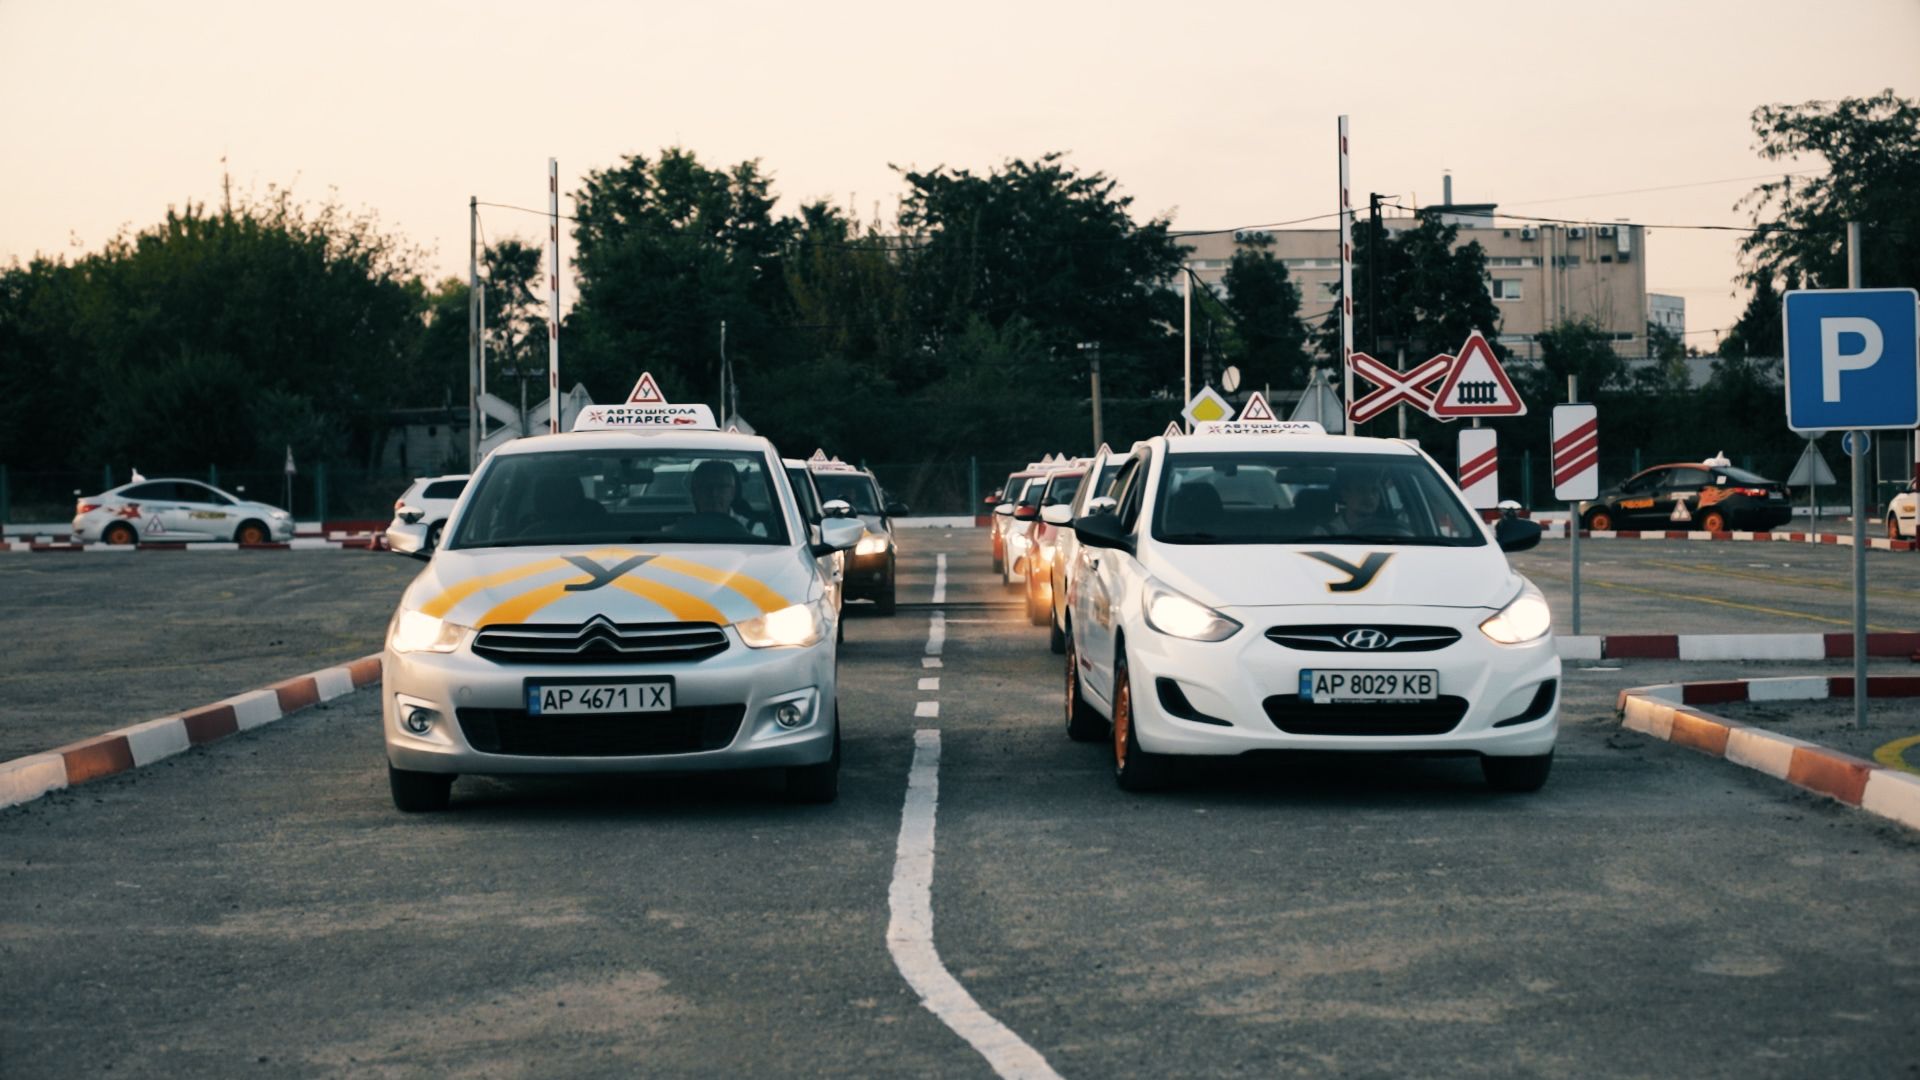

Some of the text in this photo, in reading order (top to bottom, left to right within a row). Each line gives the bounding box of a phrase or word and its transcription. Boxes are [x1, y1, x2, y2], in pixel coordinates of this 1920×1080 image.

[1820, 316, 1884, 403] P
[606, 415, 670, 424] АНТАРЕС
[1350, 674, 1398, 695] 8029
[579, 687, 628, 710] 4671
